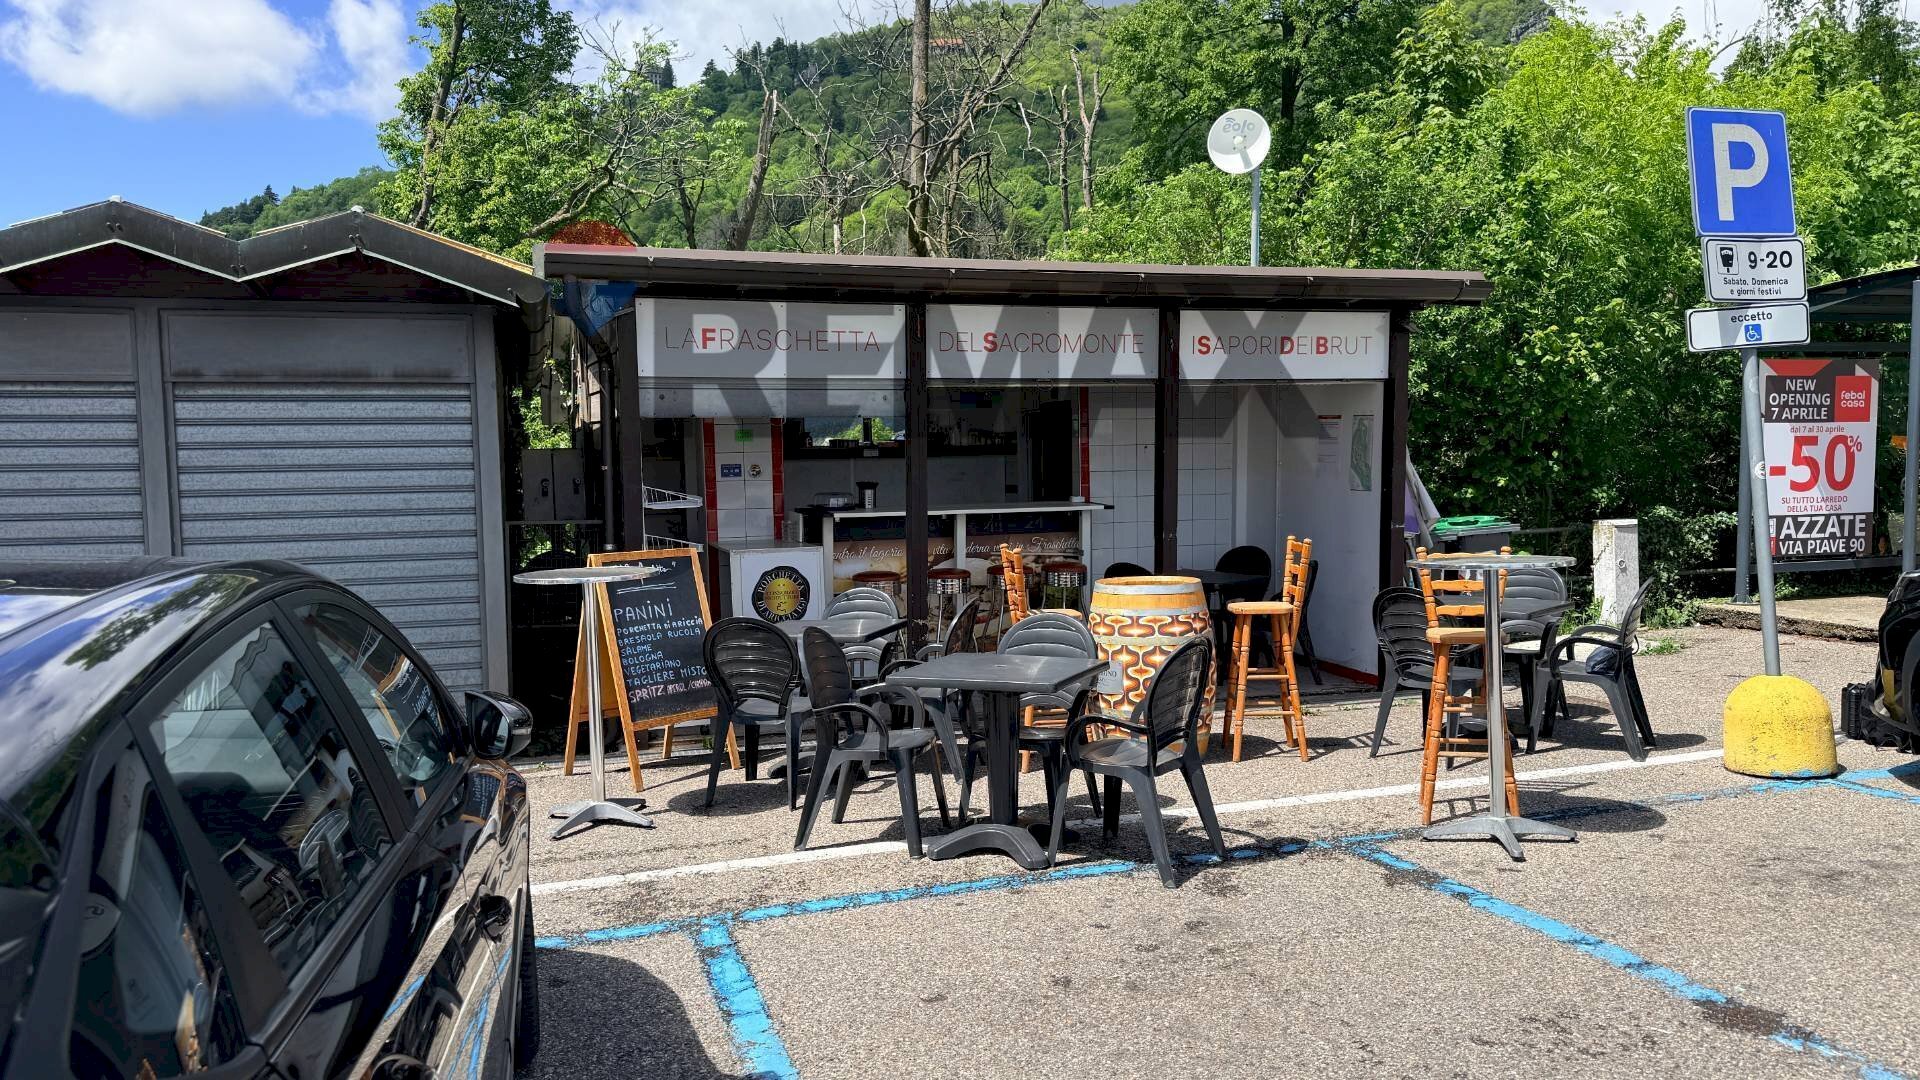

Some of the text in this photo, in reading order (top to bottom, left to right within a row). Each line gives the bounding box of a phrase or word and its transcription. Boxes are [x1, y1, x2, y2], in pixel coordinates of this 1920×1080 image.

[1711, 122, 1769, 222] P
[1748, 250, 1793, 270] 9-20
[1751, 276, 1789, 286] Domenica
[1736, 287, 1756, 296] giorni
[1757, 286, 1782, 296] festivi
[1730, 311, 1773, 323] eccetto
[1785, 378, 1817, 391] NEW
[1769, 393, 1831, 406] OPENING
[1840, 390, 1866, 400] febal
[1840, 400, 1865, 408] casa
[1771, 407, 1828, 420] 7 APRILE
[1790, 426, 1801, 434] dal
[1825, 426, 1845, 435] aprile
[1787, 505, 1808, 513] DELLA
[1779, 515, 1867, 539] AZZATE
[1779, 538, 1866, 556] VIA PIAVE 90
[618, 627, 701, 647] BRESAOLA RUCOLA
[620, 643, 653, 657] SALAME
[622, 651, 664, 666] BOLOGNA
